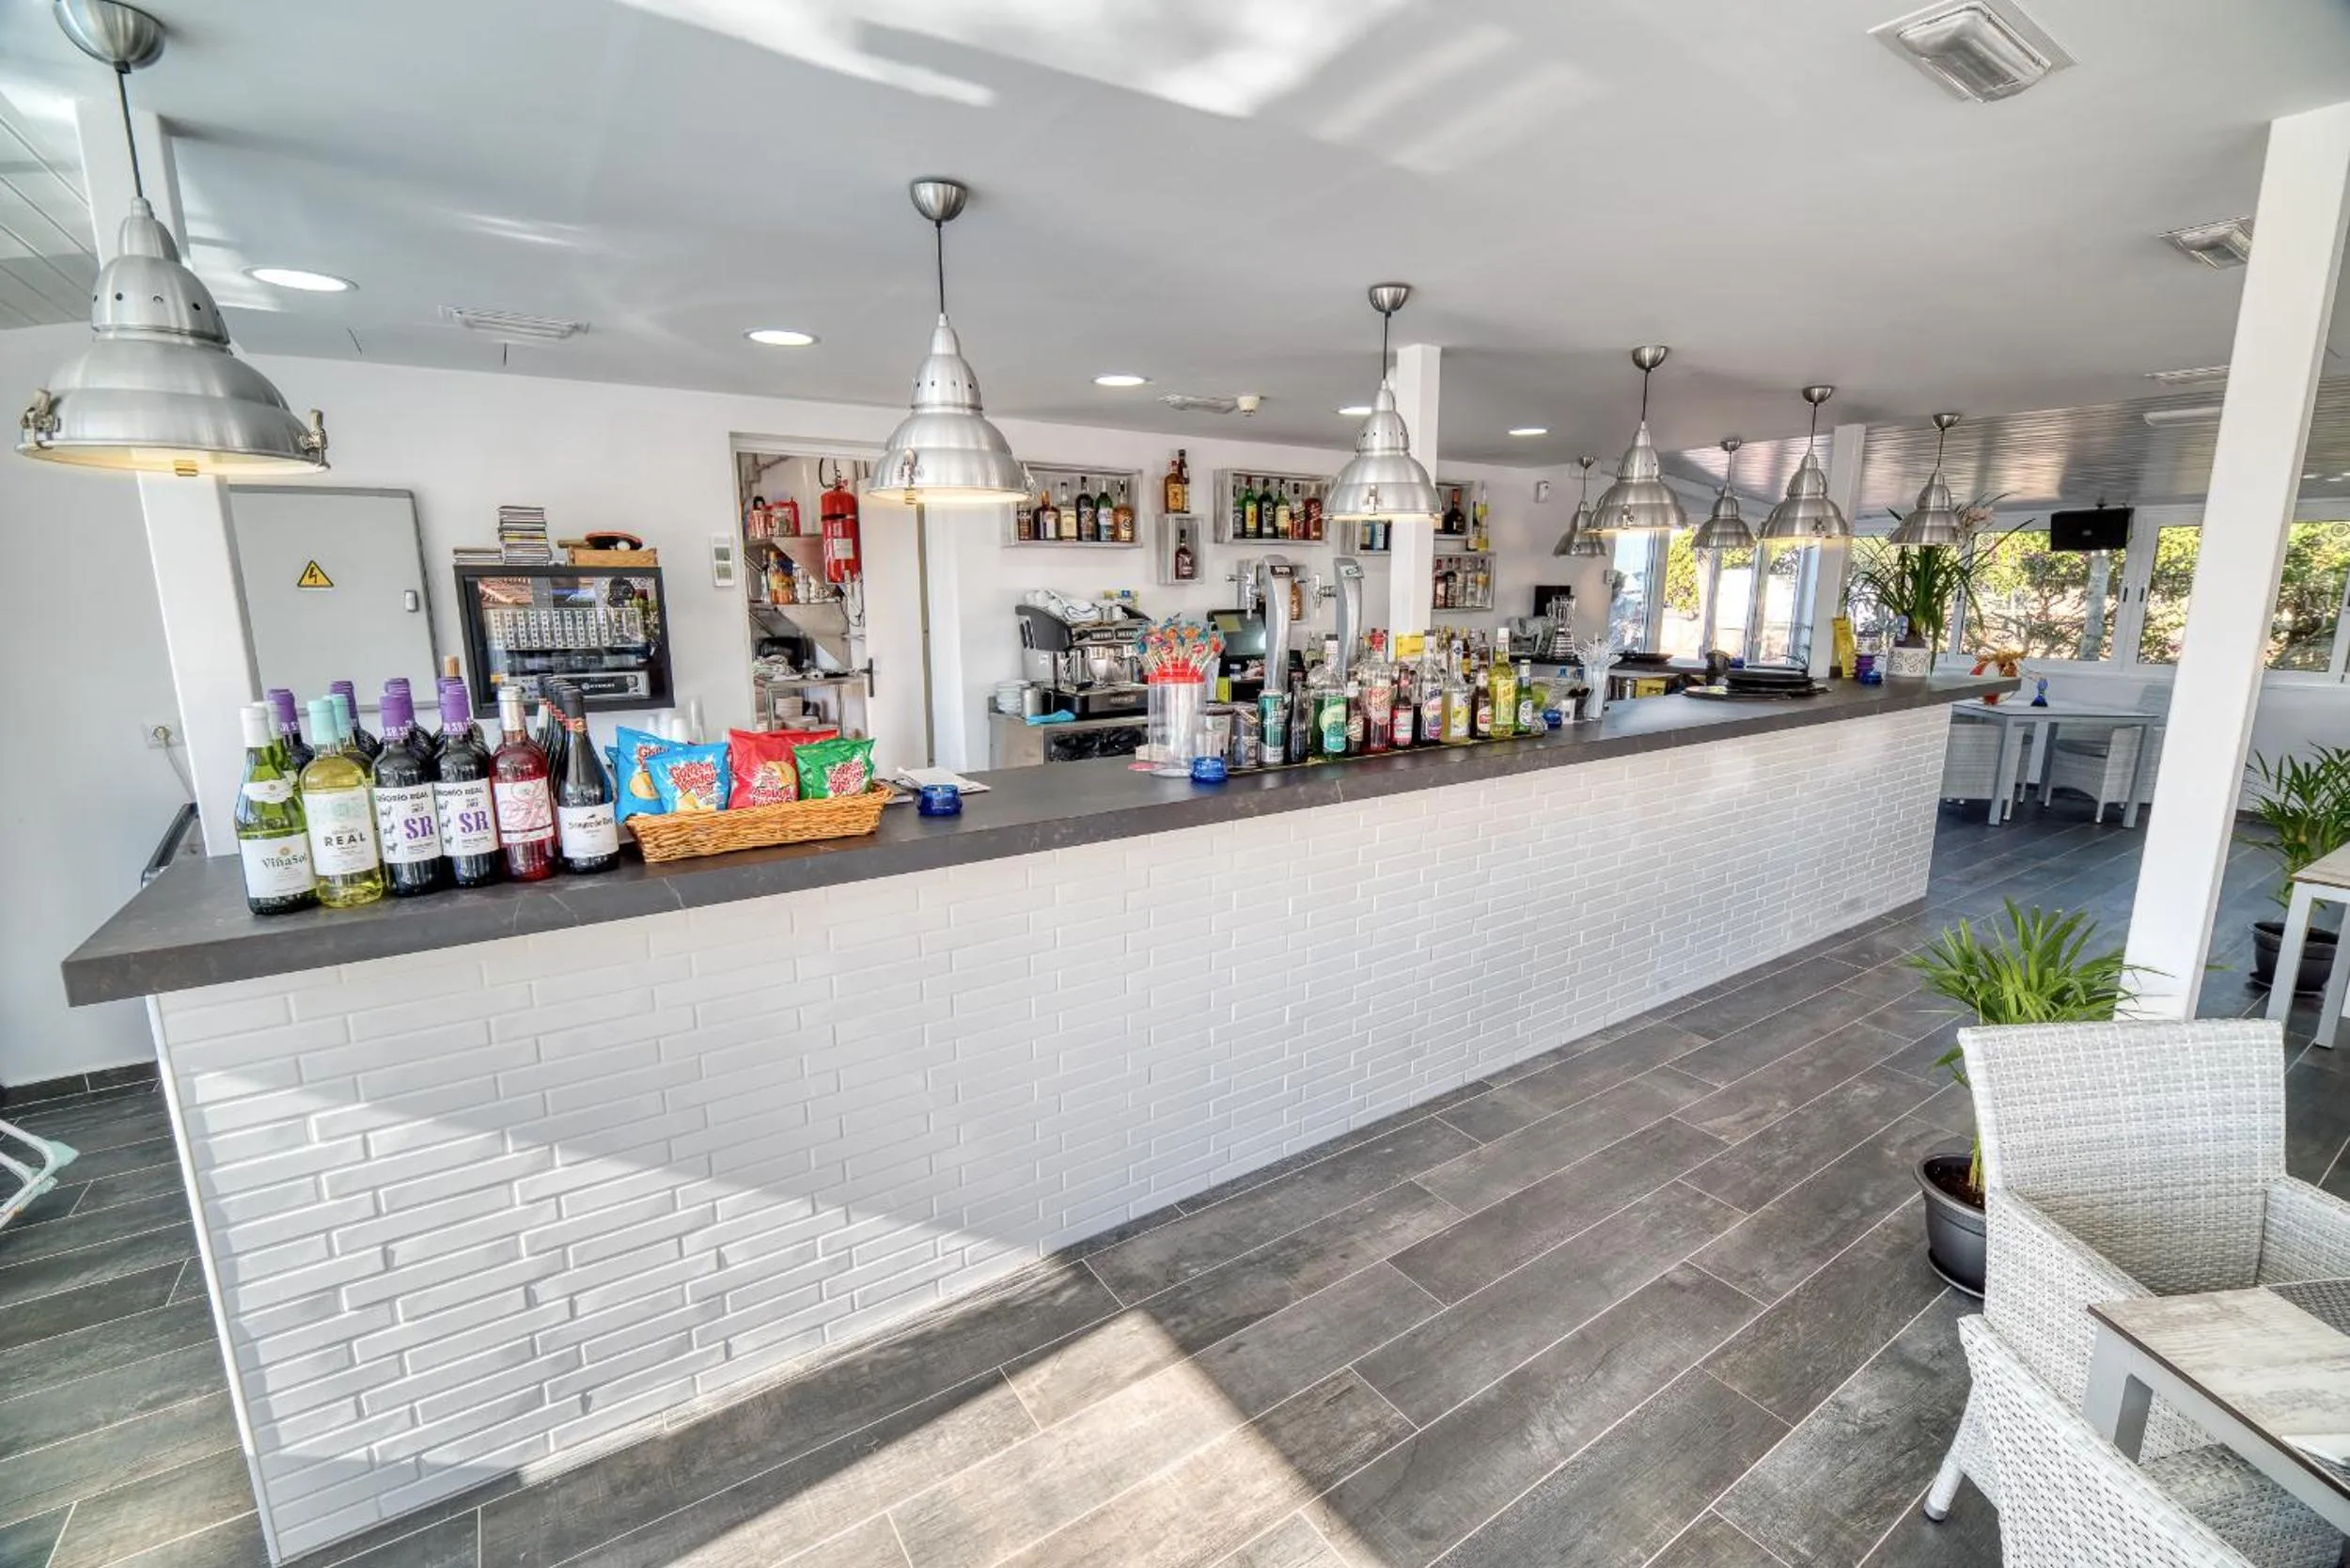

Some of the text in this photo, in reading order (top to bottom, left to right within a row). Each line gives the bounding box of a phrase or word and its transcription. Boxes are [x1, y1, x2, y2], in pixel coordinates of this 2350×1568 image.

[404, 815, 434, 839] SR
[459, 810, 489, 834] SR
[324, 833, 367, 846] REAL
